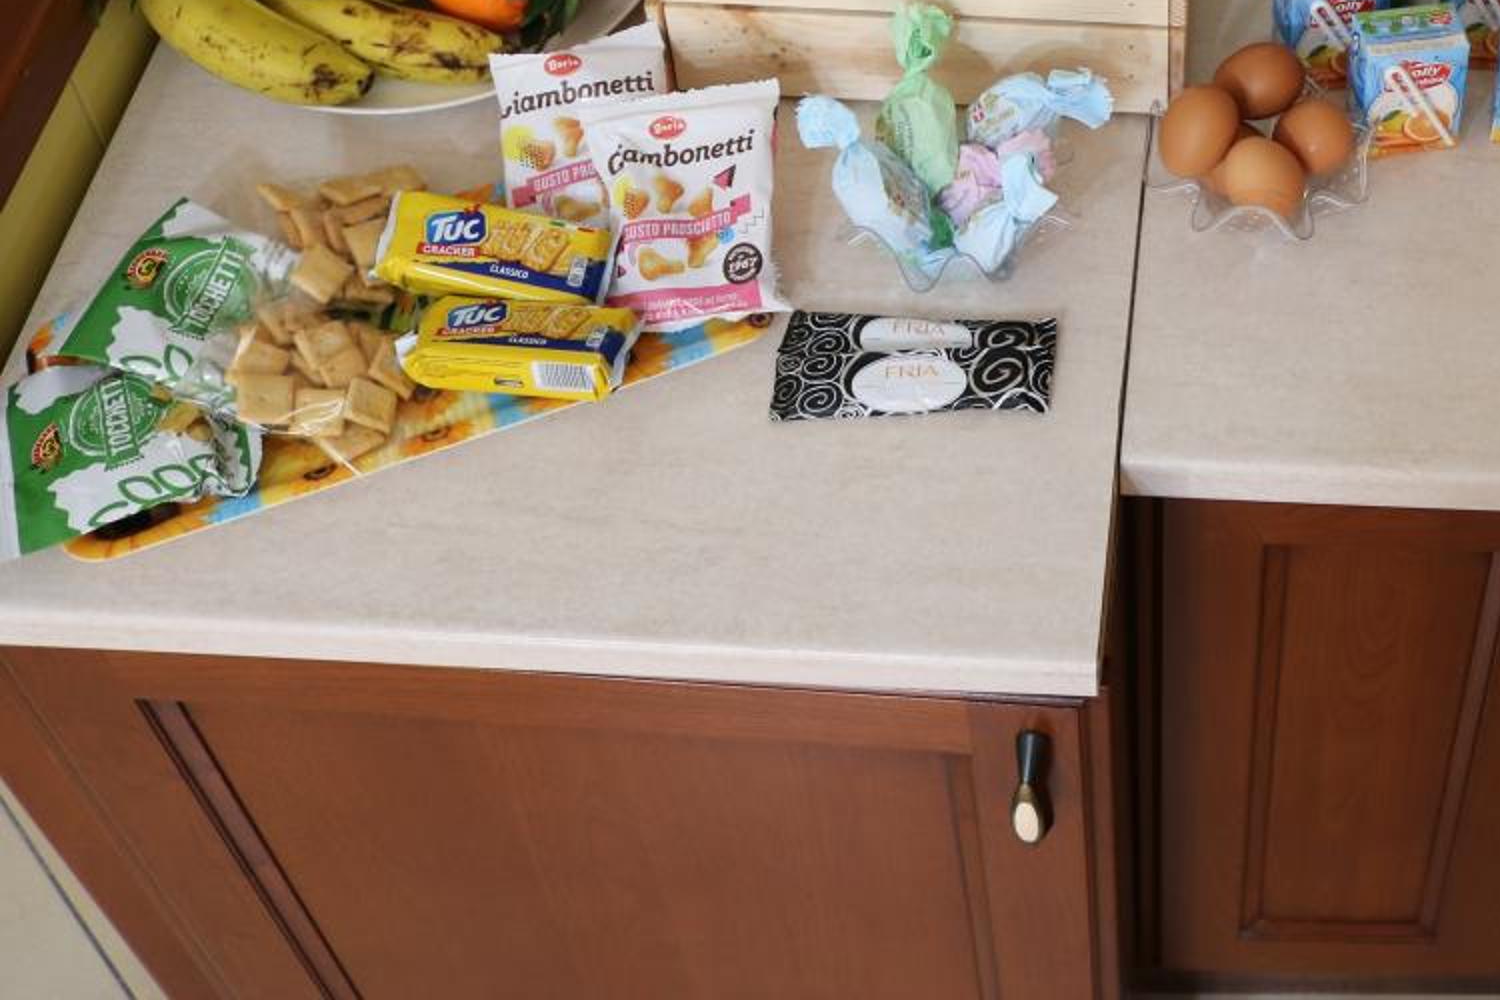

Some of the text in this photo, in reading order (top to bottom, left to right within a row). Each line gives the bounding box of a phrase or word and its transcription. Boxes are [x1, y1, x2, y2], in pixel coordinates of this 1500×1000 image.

[431, 214, 481, 243] TUC
[422, 245, 476, 257] CRACKER
[489, 264, 529, 279] CLASSICO
[453, 305, 503, 327] TUC
[885, 364, 938, 379] FRIA
[101, 380, 135, 455] TOCCHETT
